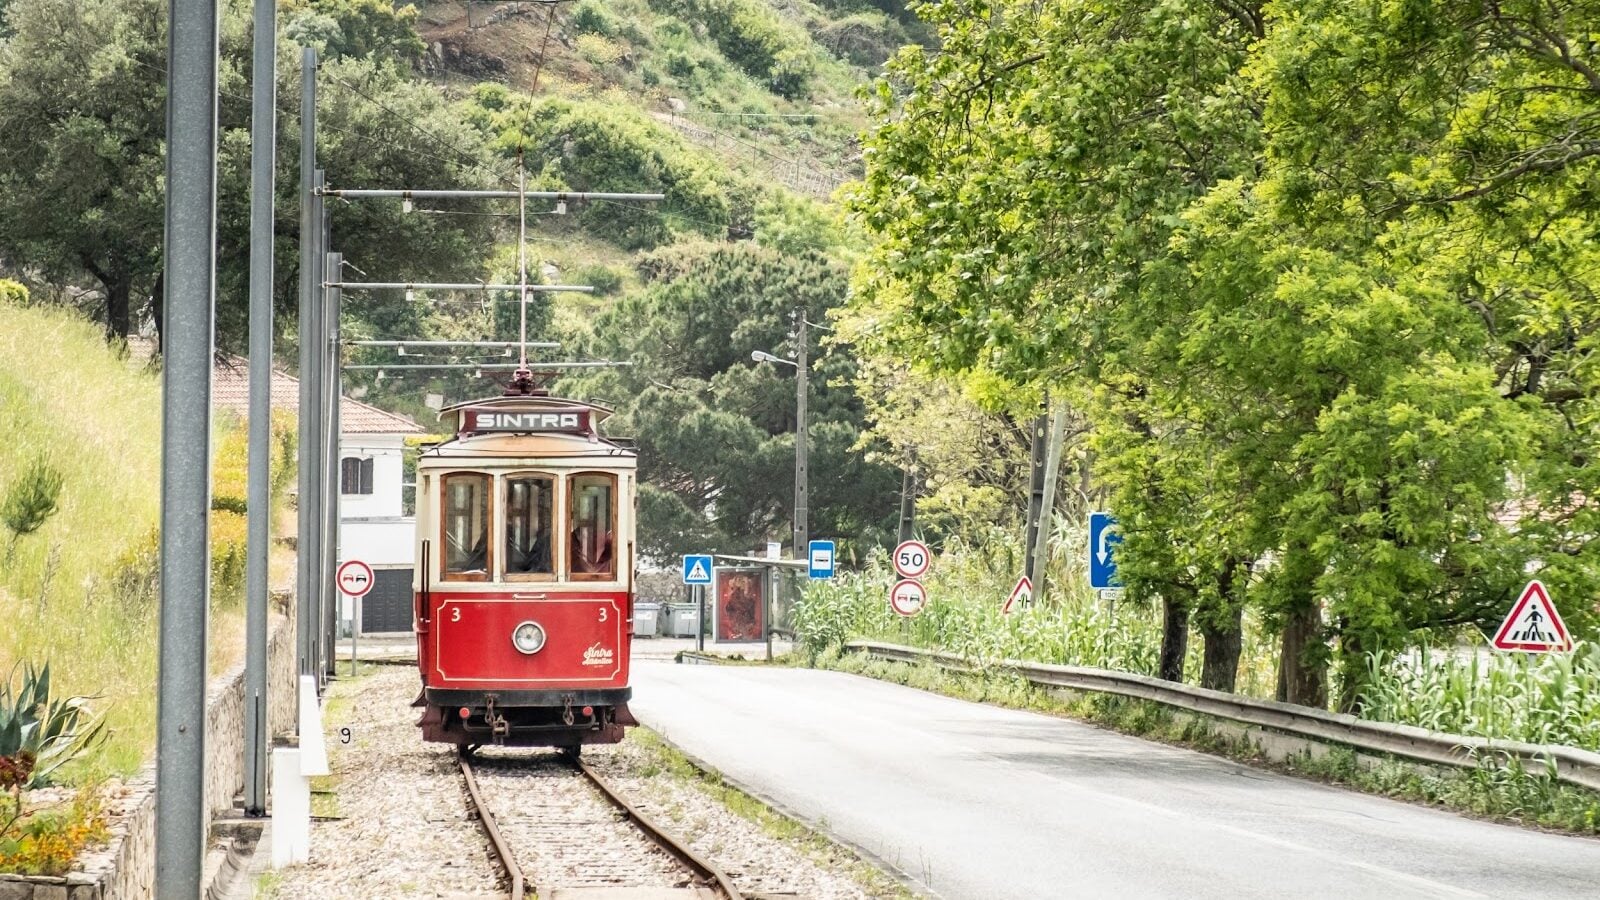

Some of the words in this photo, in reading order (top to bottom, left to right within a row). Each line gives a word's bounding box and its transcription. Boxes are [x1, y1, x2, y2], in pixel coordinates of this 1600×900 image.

[476, 413, 578, 428] SINTRA
[901, 552, 924, 567] 50
[451, 607, 460, 622] 3
[598, 607, 607, 622] 3
[341, 727, 351, 744] 9
